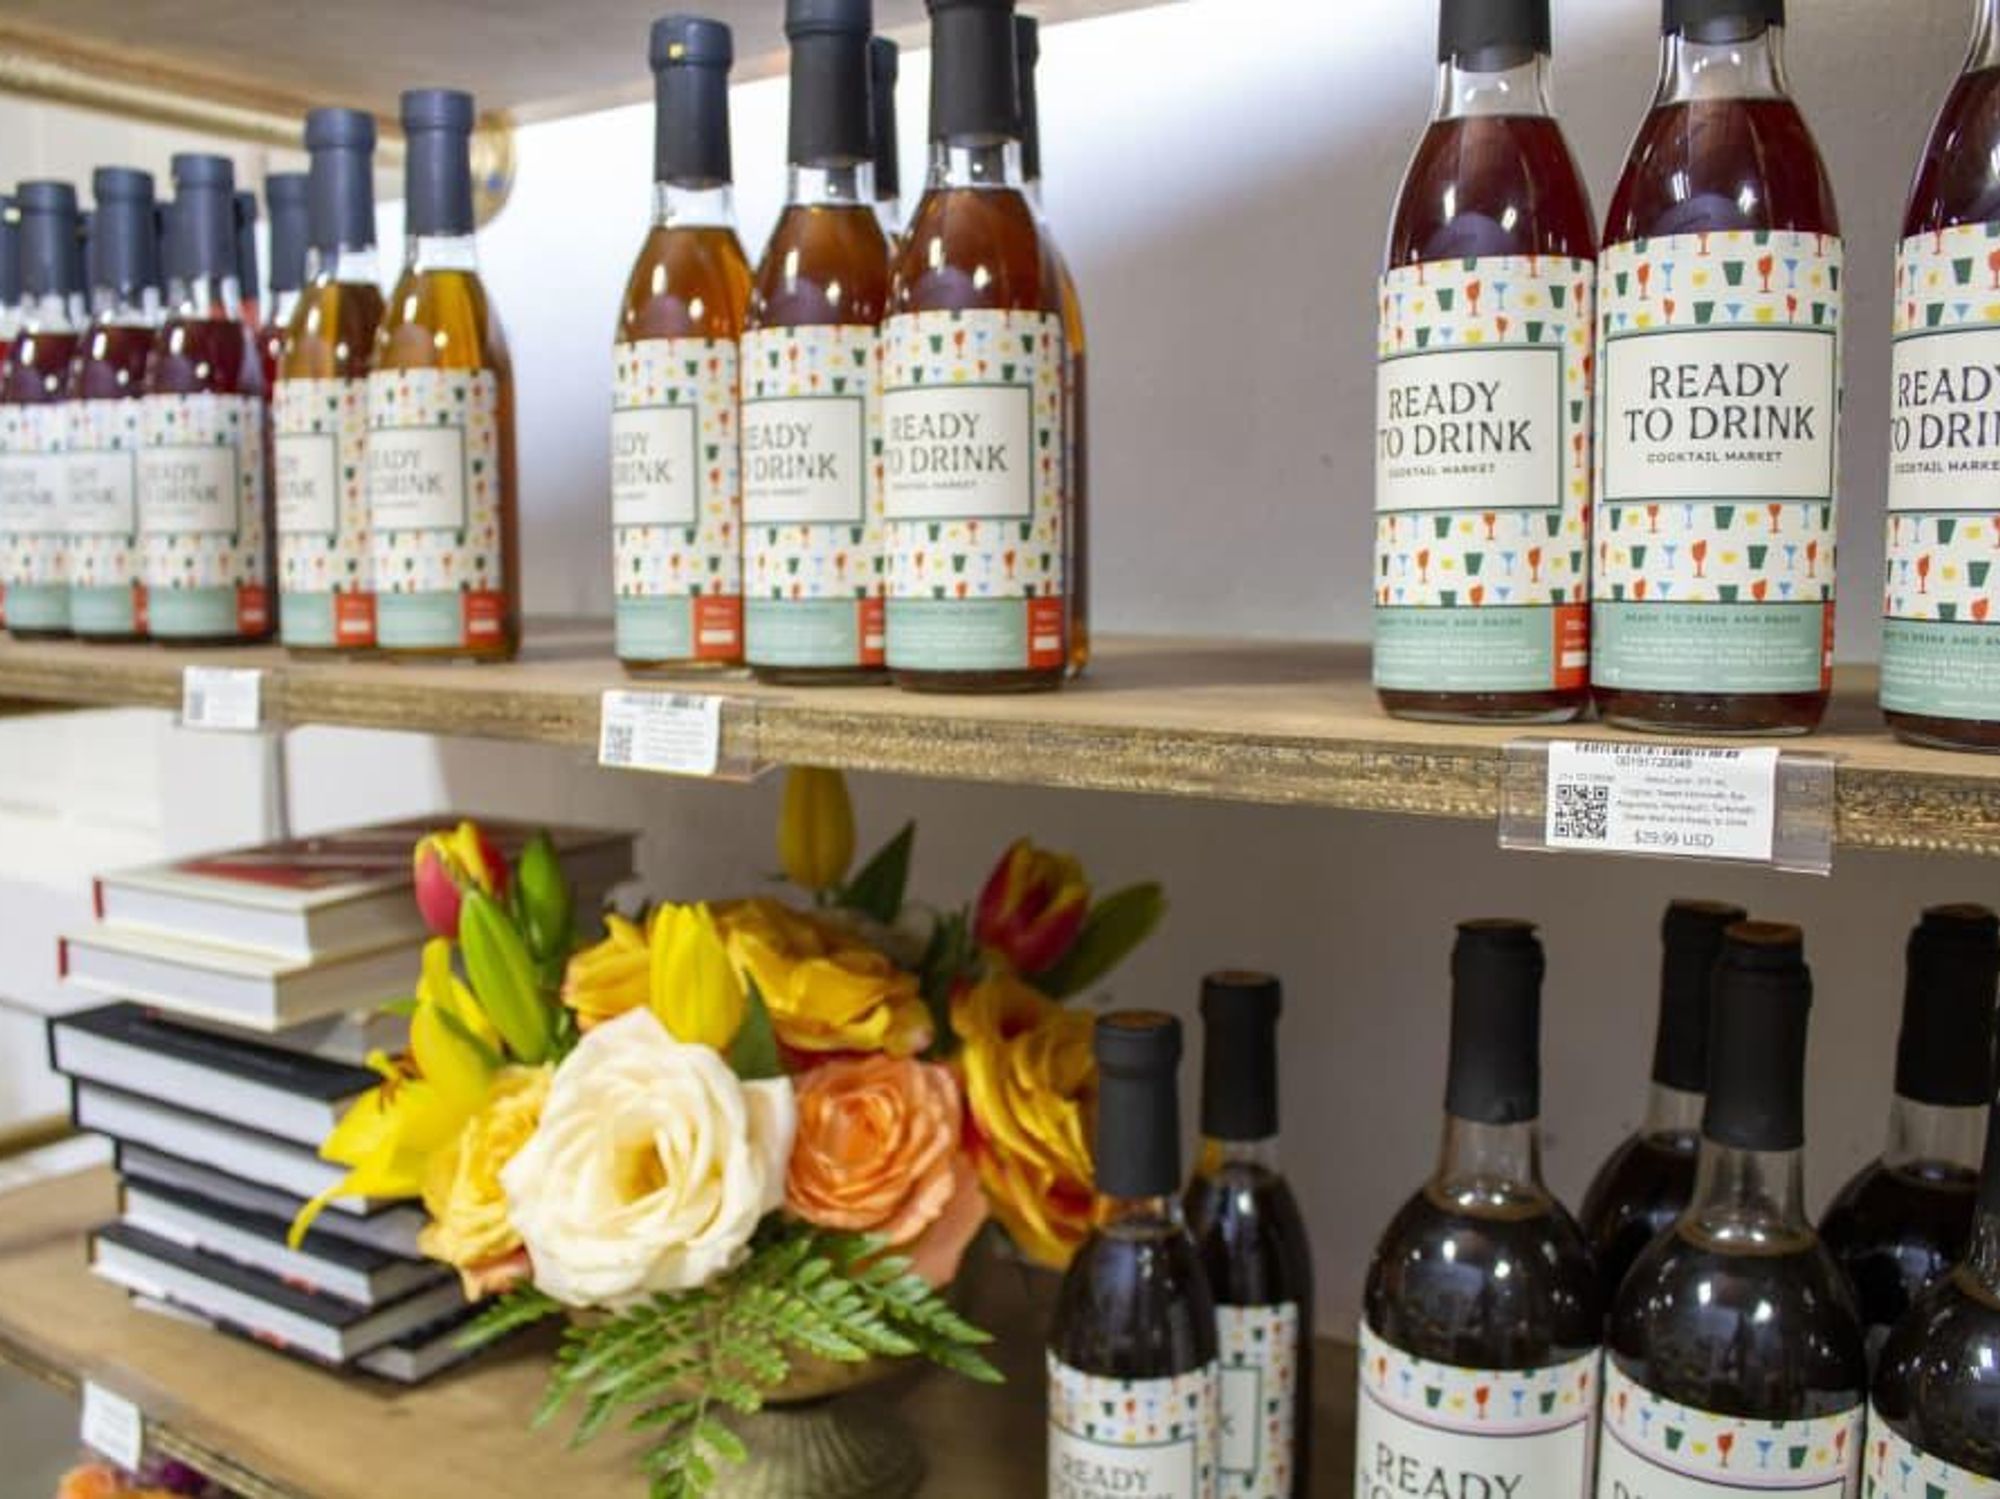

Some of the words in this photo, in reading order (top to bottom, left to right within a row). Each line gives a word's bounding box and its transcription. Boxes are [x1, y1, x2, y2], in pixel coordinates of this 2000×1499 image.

[1649, 362, 1789, 400] READY
[1388, 380, 1501, 421] READY
[742, 422, 812, 451] EADY
[890, 412, 980, 443] READY
[1414, 419, 1532, 456] DRINK
[1624, 407, 1673, 442] TO
[1690, 404, 1814, 440] DRINK
[1919, 410, 2000, 450] DRI
[754, 452, 838, 482] DRINK
[910, 444, 1008, 474] DRINK
[1442, 462, 1496, 475] MARKET
[1647, 452, 1720, 463] COCKTAIL
[1725, 451, 1783, 462] MARKET
[1948, 460, 2000, 472] MARKE
[1376, 1440, 1523, 1499] READY
